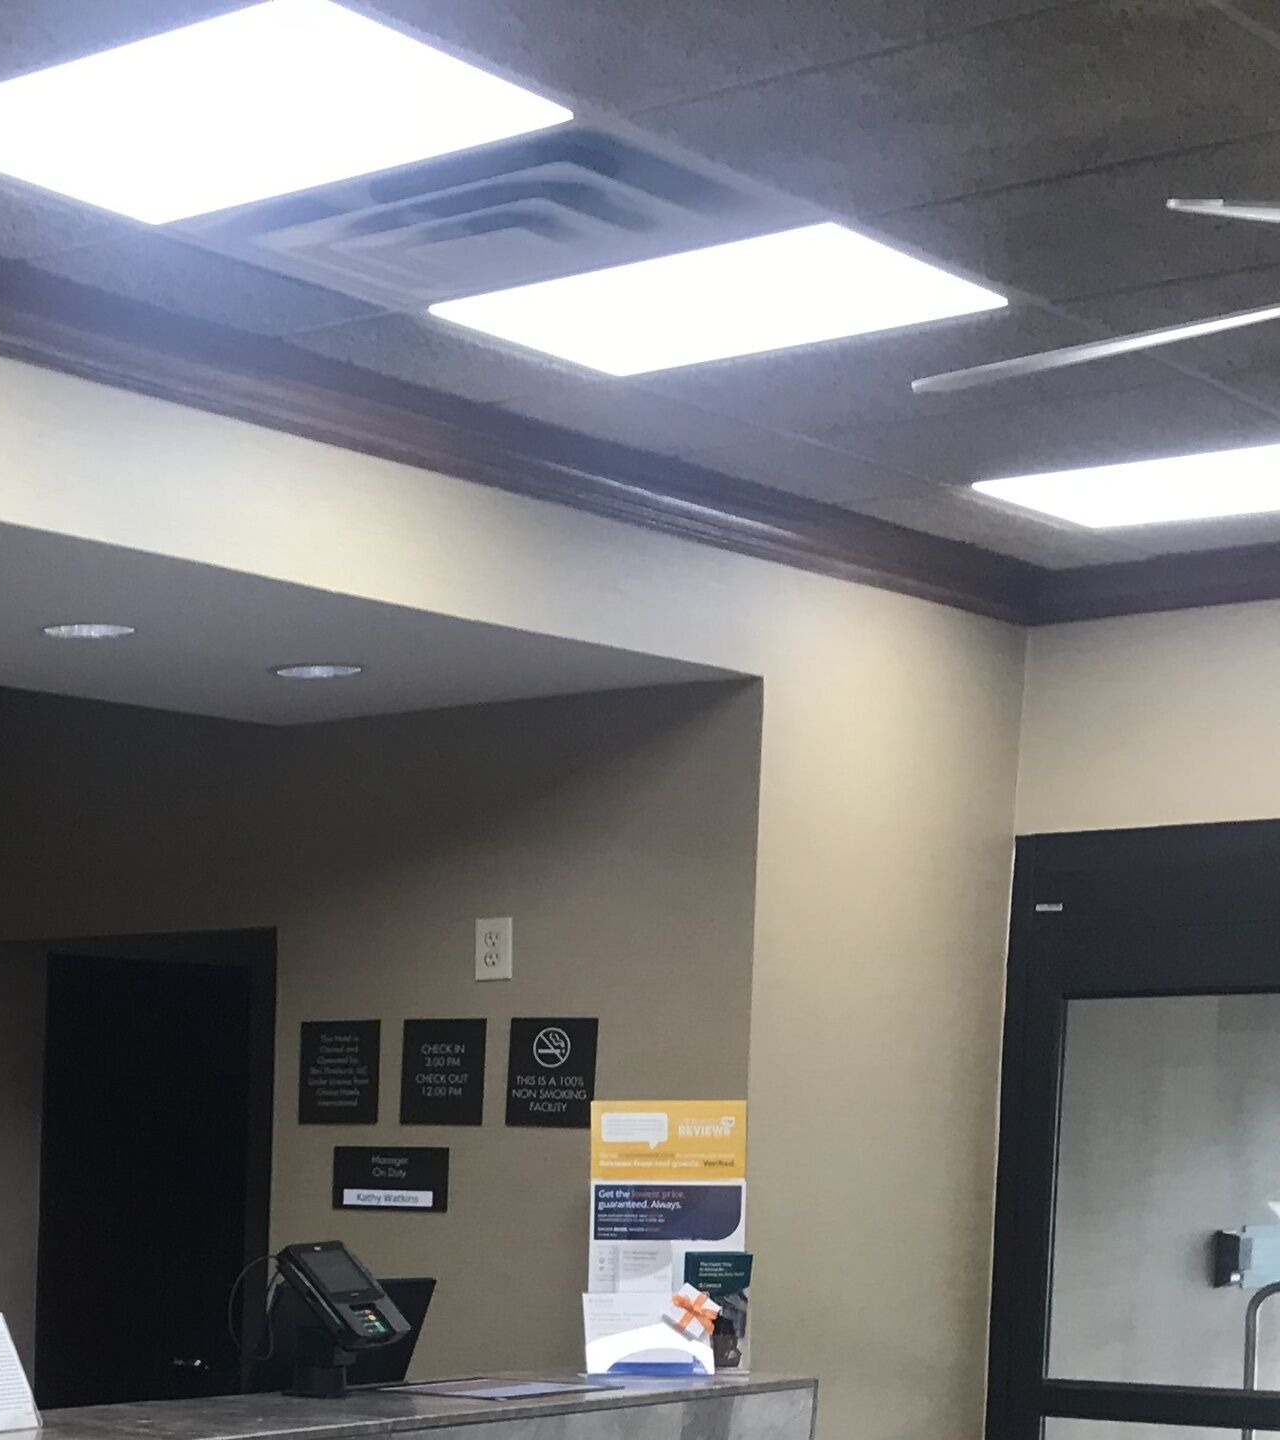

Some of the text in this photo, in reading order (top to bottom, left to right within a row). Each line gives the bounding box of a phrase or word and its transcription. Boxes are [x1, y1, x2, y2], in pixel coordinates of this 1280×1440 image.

[421, 1043, 465, 1055] CHECK IN
[447, 1056, 461, 1067] PM
[416, 1073, 469, 1084] CHECK OUT
[516, 1075, 585, 1087] THIS IS A 100%
[448, 1086, 462, 1097] PM
[512, 1088, 587, 1100] NON SMOKING
[529, 1101, 568, 1112] FACILITY
[356, 1192, 381, 1205] Kathy
[598, 1189, 614, 1198] Get
[615, 1189, 630, 1198] the
